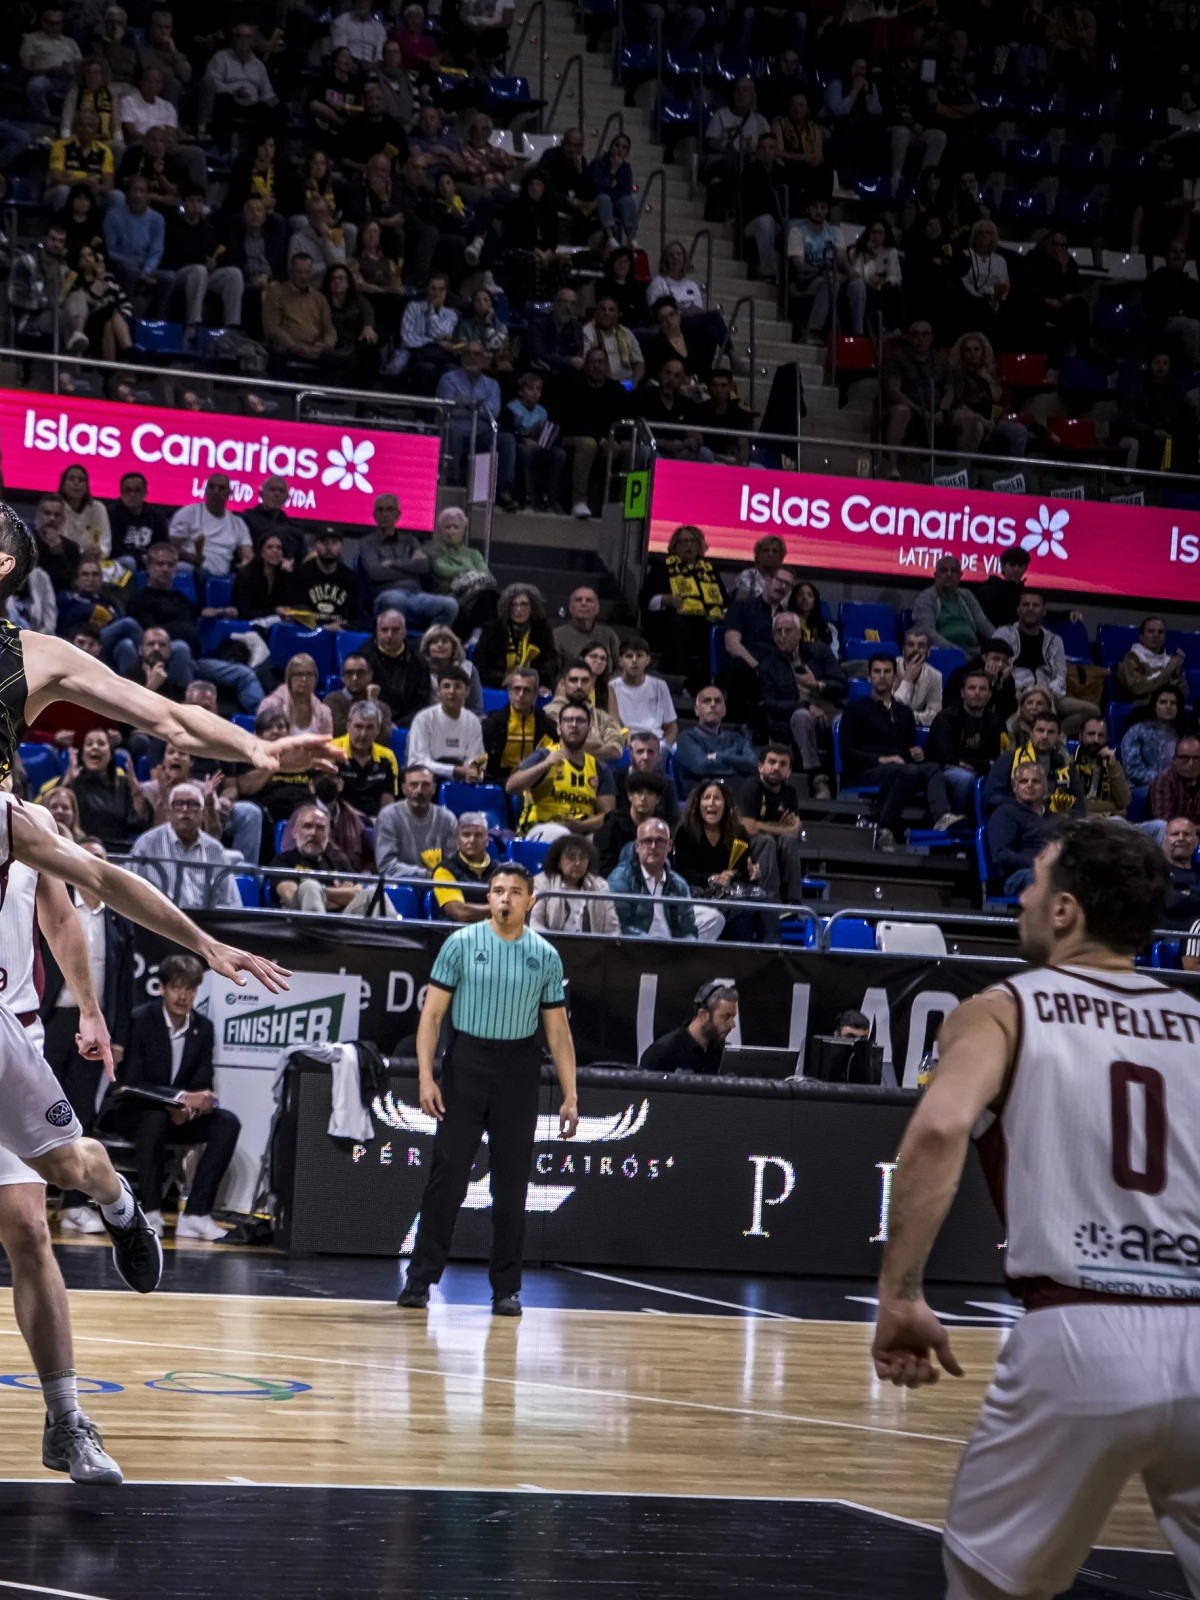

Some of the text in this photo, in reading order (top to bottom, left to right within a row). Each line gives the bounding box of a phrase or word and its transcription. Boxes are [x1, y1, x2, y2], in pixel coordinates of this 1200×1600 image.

[24, 409, 319, 479] Islas Canarias
[630, 480, 642, 509] P
[740, 484, 1016, 546] Islas Canarias
[899, 546, 953, 570] LATIT
[961, 553, 978, 572] DE
[226, 1006, 333, 1044] FINISHER
[1110, 1060, 1168, 1196] 0
[1148, 1282, 1167, 1295] to
